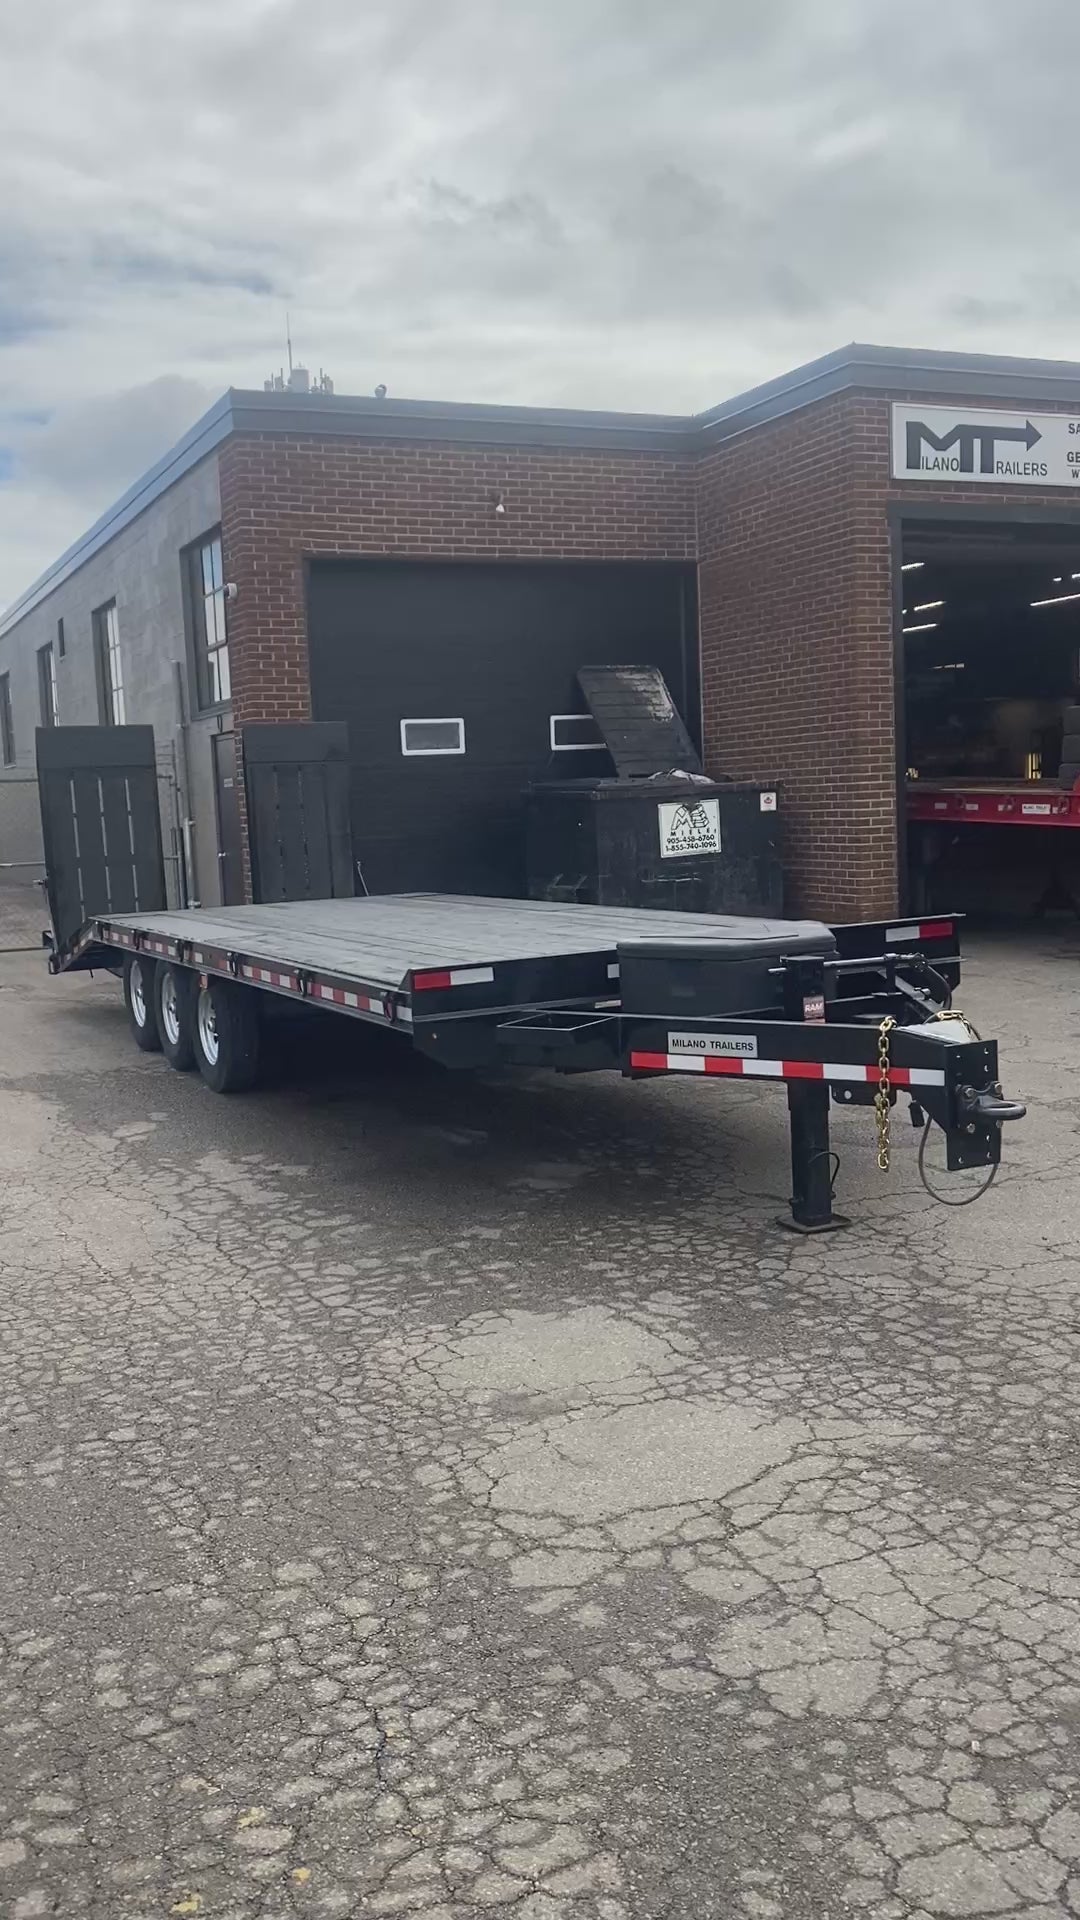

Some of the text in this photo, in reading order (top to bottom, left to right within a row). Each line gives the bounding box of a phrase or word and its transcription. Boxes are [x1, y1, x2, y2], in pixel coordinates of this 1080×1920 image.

[1067, 451, 1080, 463] GE
[1072, 468, 1080, 478] W
[672, 1039, 754, 1051] MILANO TRAILERS
